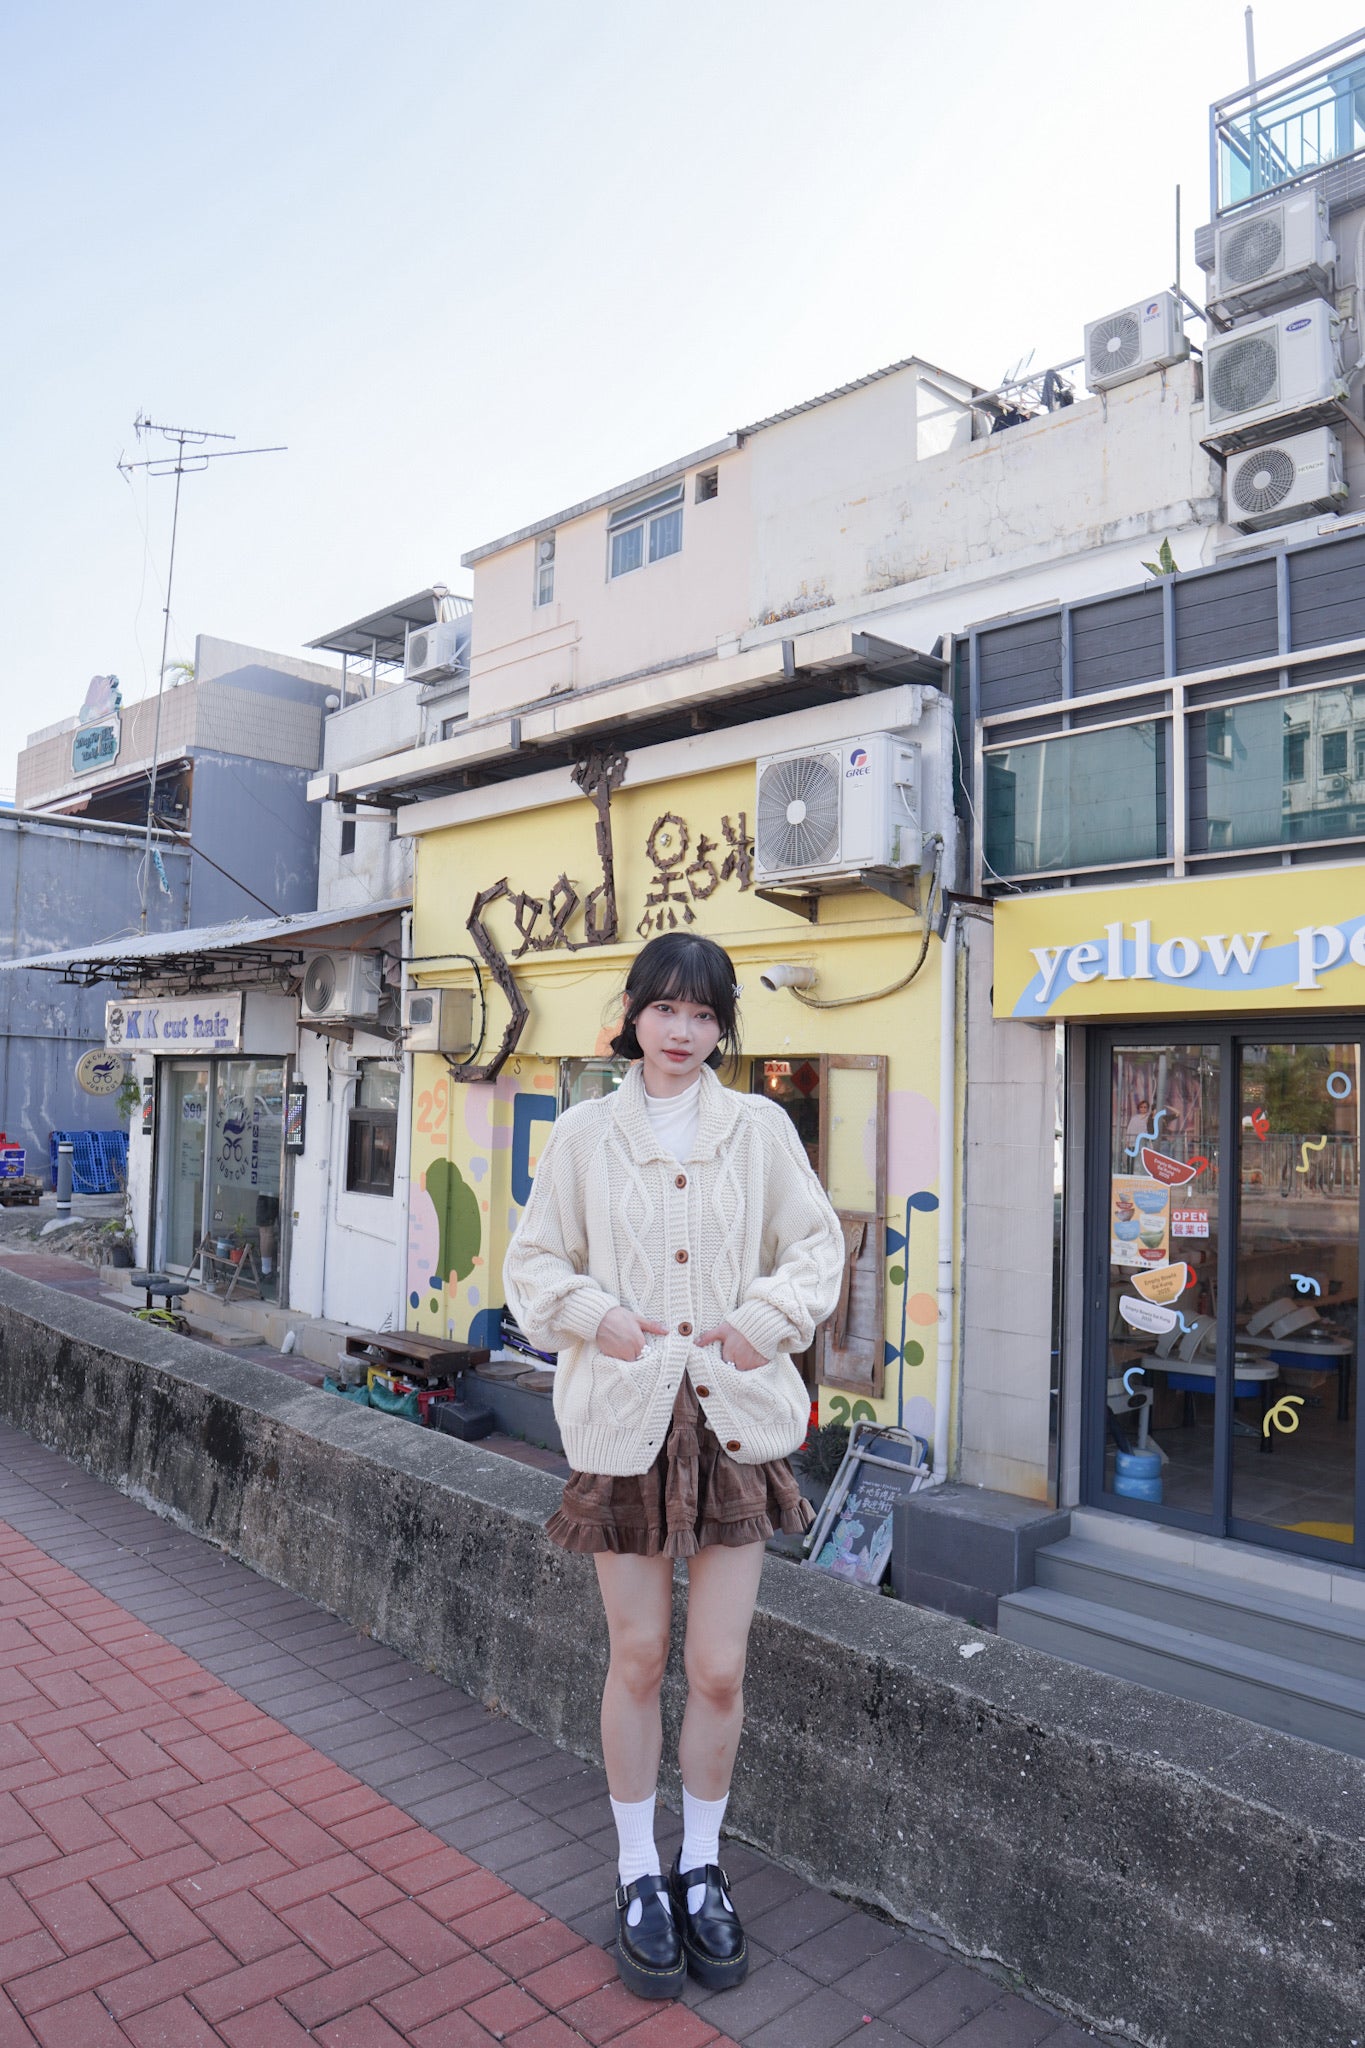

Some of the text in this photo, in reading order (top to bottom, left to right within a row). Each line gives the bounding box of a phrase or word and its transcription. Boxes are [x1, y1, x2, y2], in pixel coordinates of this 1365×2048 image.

[846, 766, 871, 778] GREE
[448, 743, 629, 1083] Seed
[1029, 920, 1270, 1003] yellow
[163, 1017, 189, 1038] cut
[193, 1011, 229, 1038] hair
[765, 1064, 787, 1073] AXI
[86, 1080, 119, 1092] JUST CUT
[417, 1078, 448, 1133] 29
[216, 1156, 233, 1180] JUST
[235, 1156, 249, 1180] CUT
[1172, 1211, 1208, 1221] OPEN
[1174, 1224, 1207, 1235] 營業中
